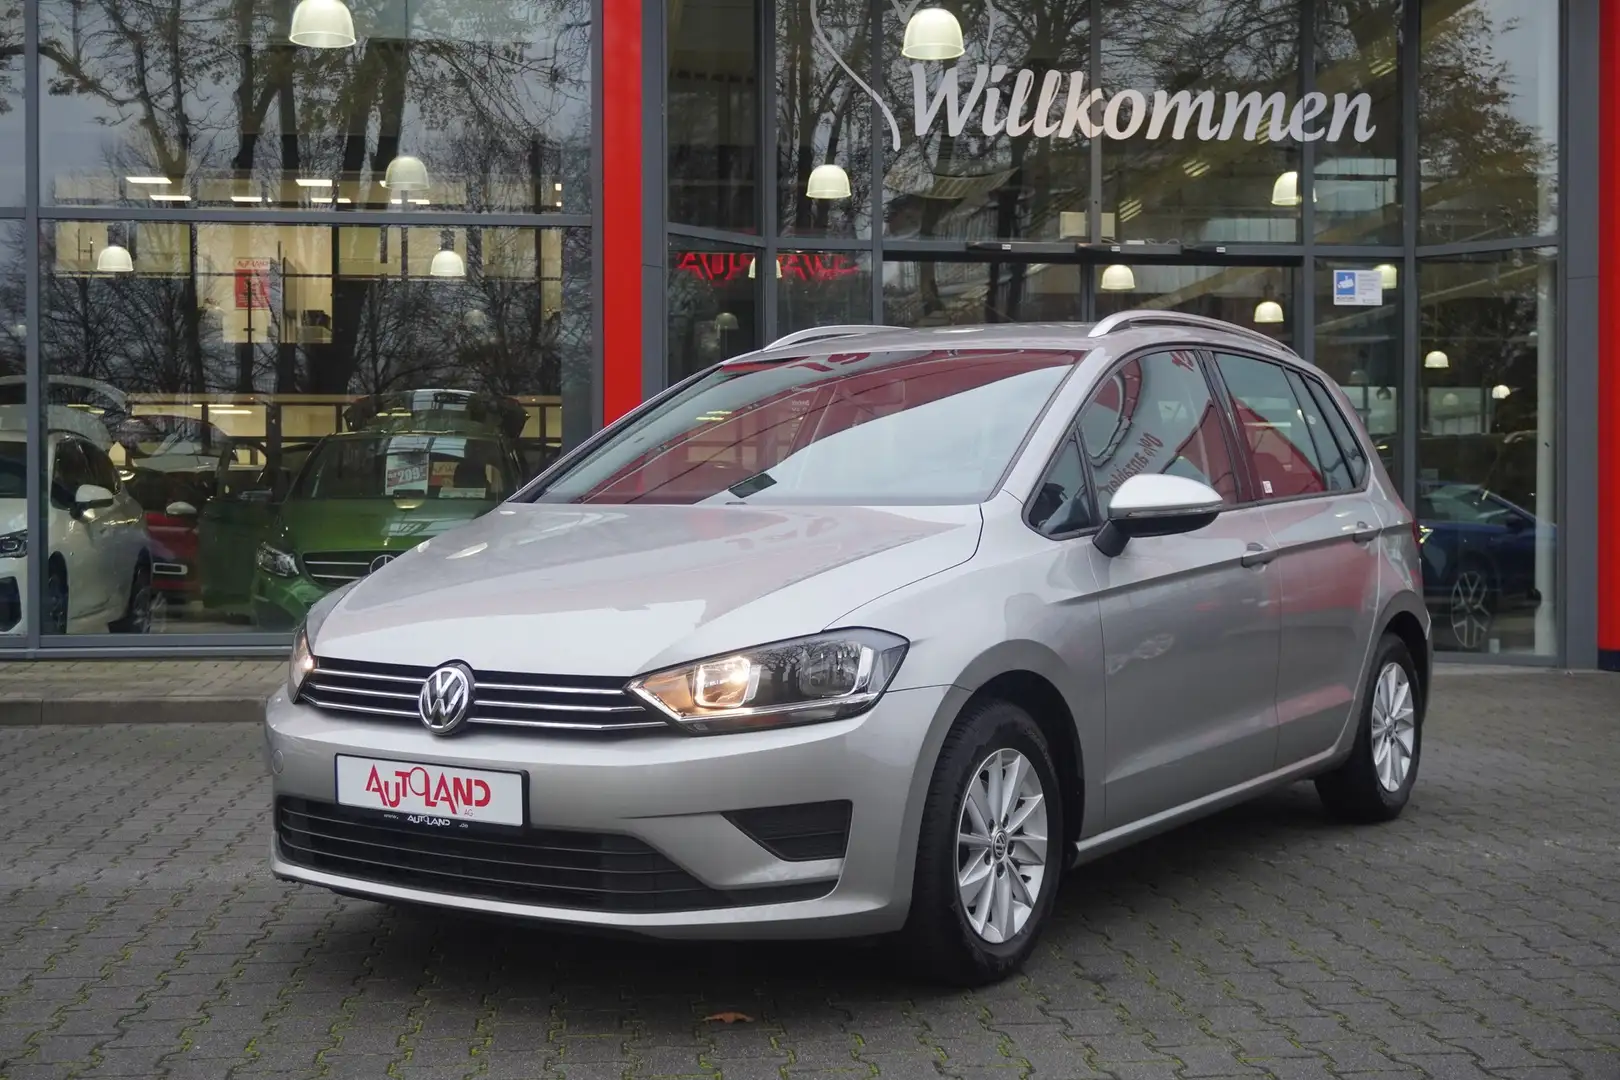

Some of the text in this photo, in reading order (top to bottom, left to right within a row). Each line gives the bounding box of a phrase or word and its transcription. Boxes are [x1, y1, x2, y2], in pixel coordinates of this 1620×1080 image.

[911, 62, 1377, 142] Willkommen
[420, 667, 469, 729] VW
[365, 763, 491, 815] AUTOLAND
[463, 808, 474, 817] AG
[407, 814, 451, 827] AUTOLAND
